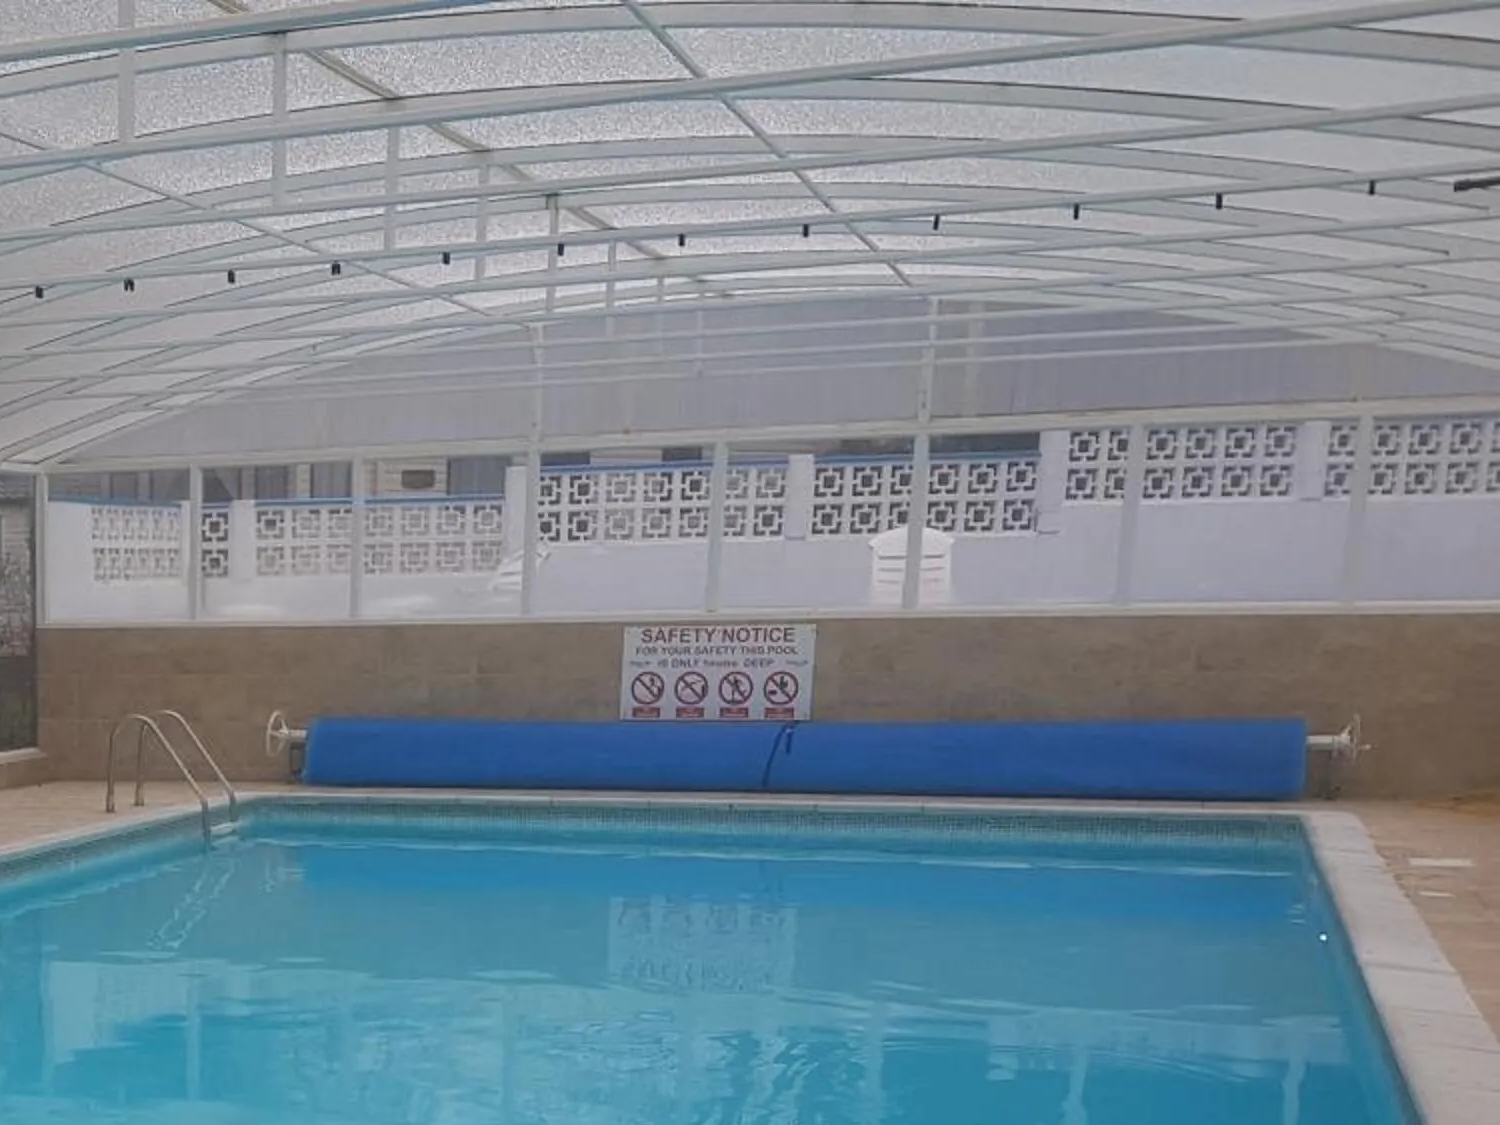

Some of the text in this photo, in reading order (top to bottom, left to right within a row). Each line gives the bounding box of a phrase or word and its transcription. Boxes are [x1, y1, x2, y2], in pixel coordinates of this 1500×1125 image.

[641, 628, 795, 643] SAFETY NOTICE
[636, 645, 799, 656] FOR YOUR SAFETY THIS POOL
[671, 658, 700, 668] ONLY
[744, 658, 775, 668] DEEP
